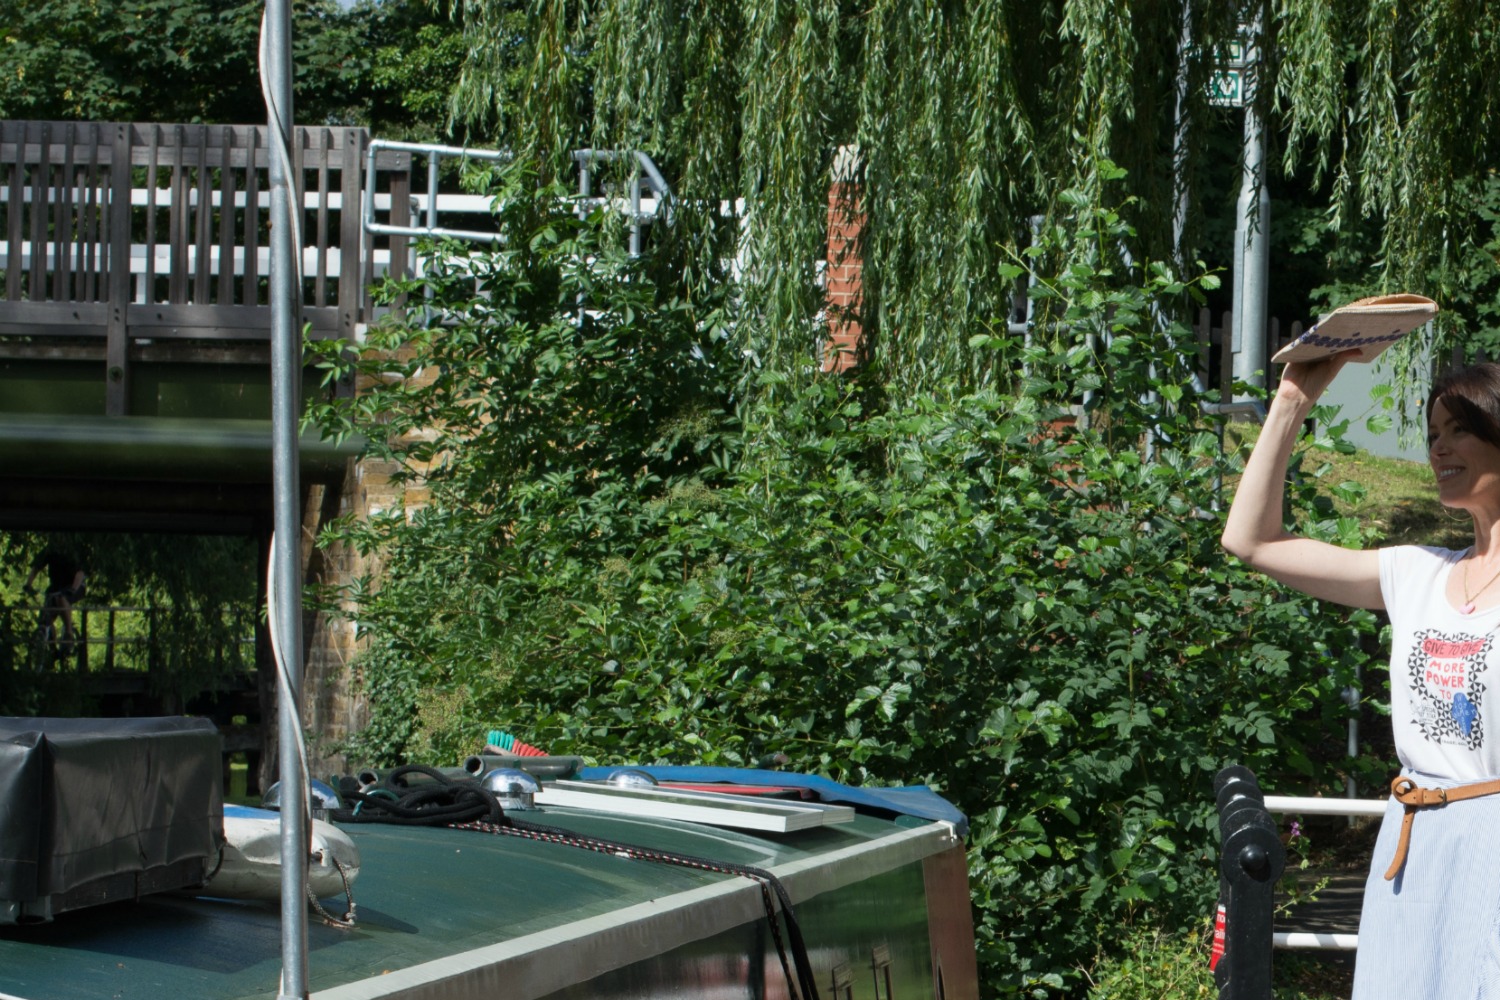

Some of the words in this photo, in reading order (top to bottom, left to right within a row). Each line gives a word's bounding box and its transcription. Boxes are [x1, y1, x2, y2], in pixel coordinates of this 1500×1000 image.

[1424, 640, 1447, 655] GIVE
[1449, 645, 1461, 656] TO
[1460, 640, 1482, 655] GIVE
[1429, 661, 1465, 673] MORE
[1426, 671, 1465, 688] POWER
[1439, 689, 1452, 700] TO
